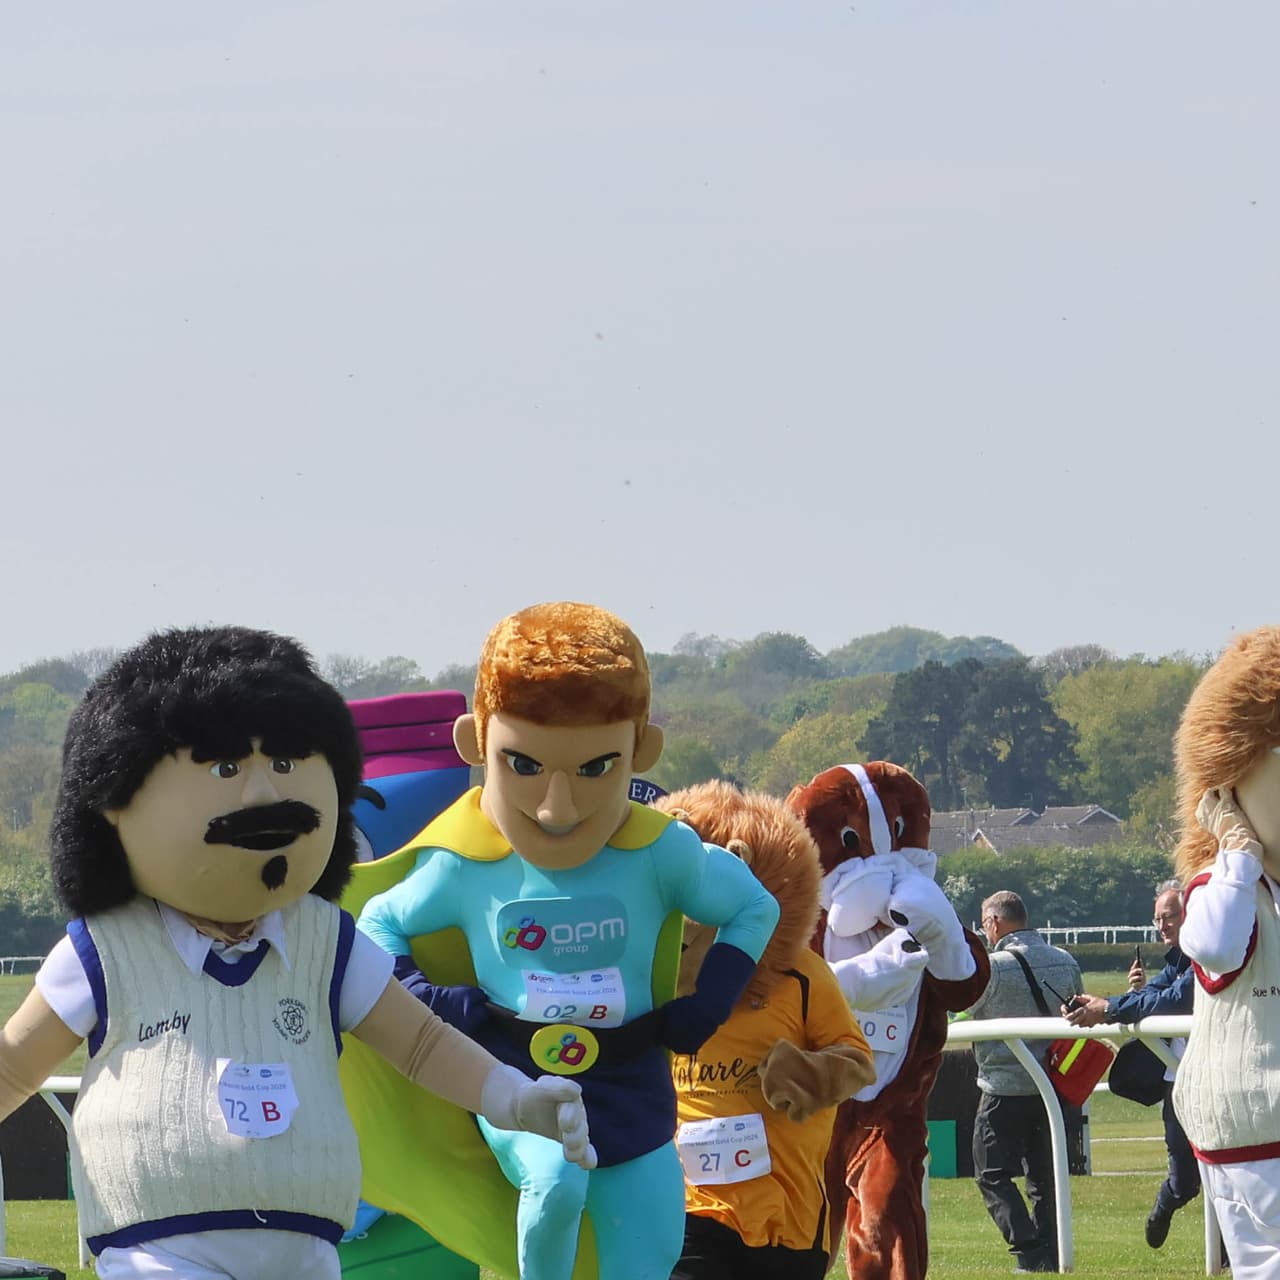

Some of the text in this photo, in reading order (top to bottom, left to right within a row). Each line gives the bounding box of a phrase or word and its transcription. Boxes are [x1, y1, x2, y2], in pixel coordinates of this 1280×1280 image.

[553, 944, 589, 956] group
[1252, 987, 1267, 997] Sue
[543, 1004, 608, 1020] 02 B
[138, 1010, 191, 1042] Lamby
[886, 1024, 897, 1041] C
[225, 1098, 281, 1122] 72 B
[699, 1149, 751, 1171] 27 C
